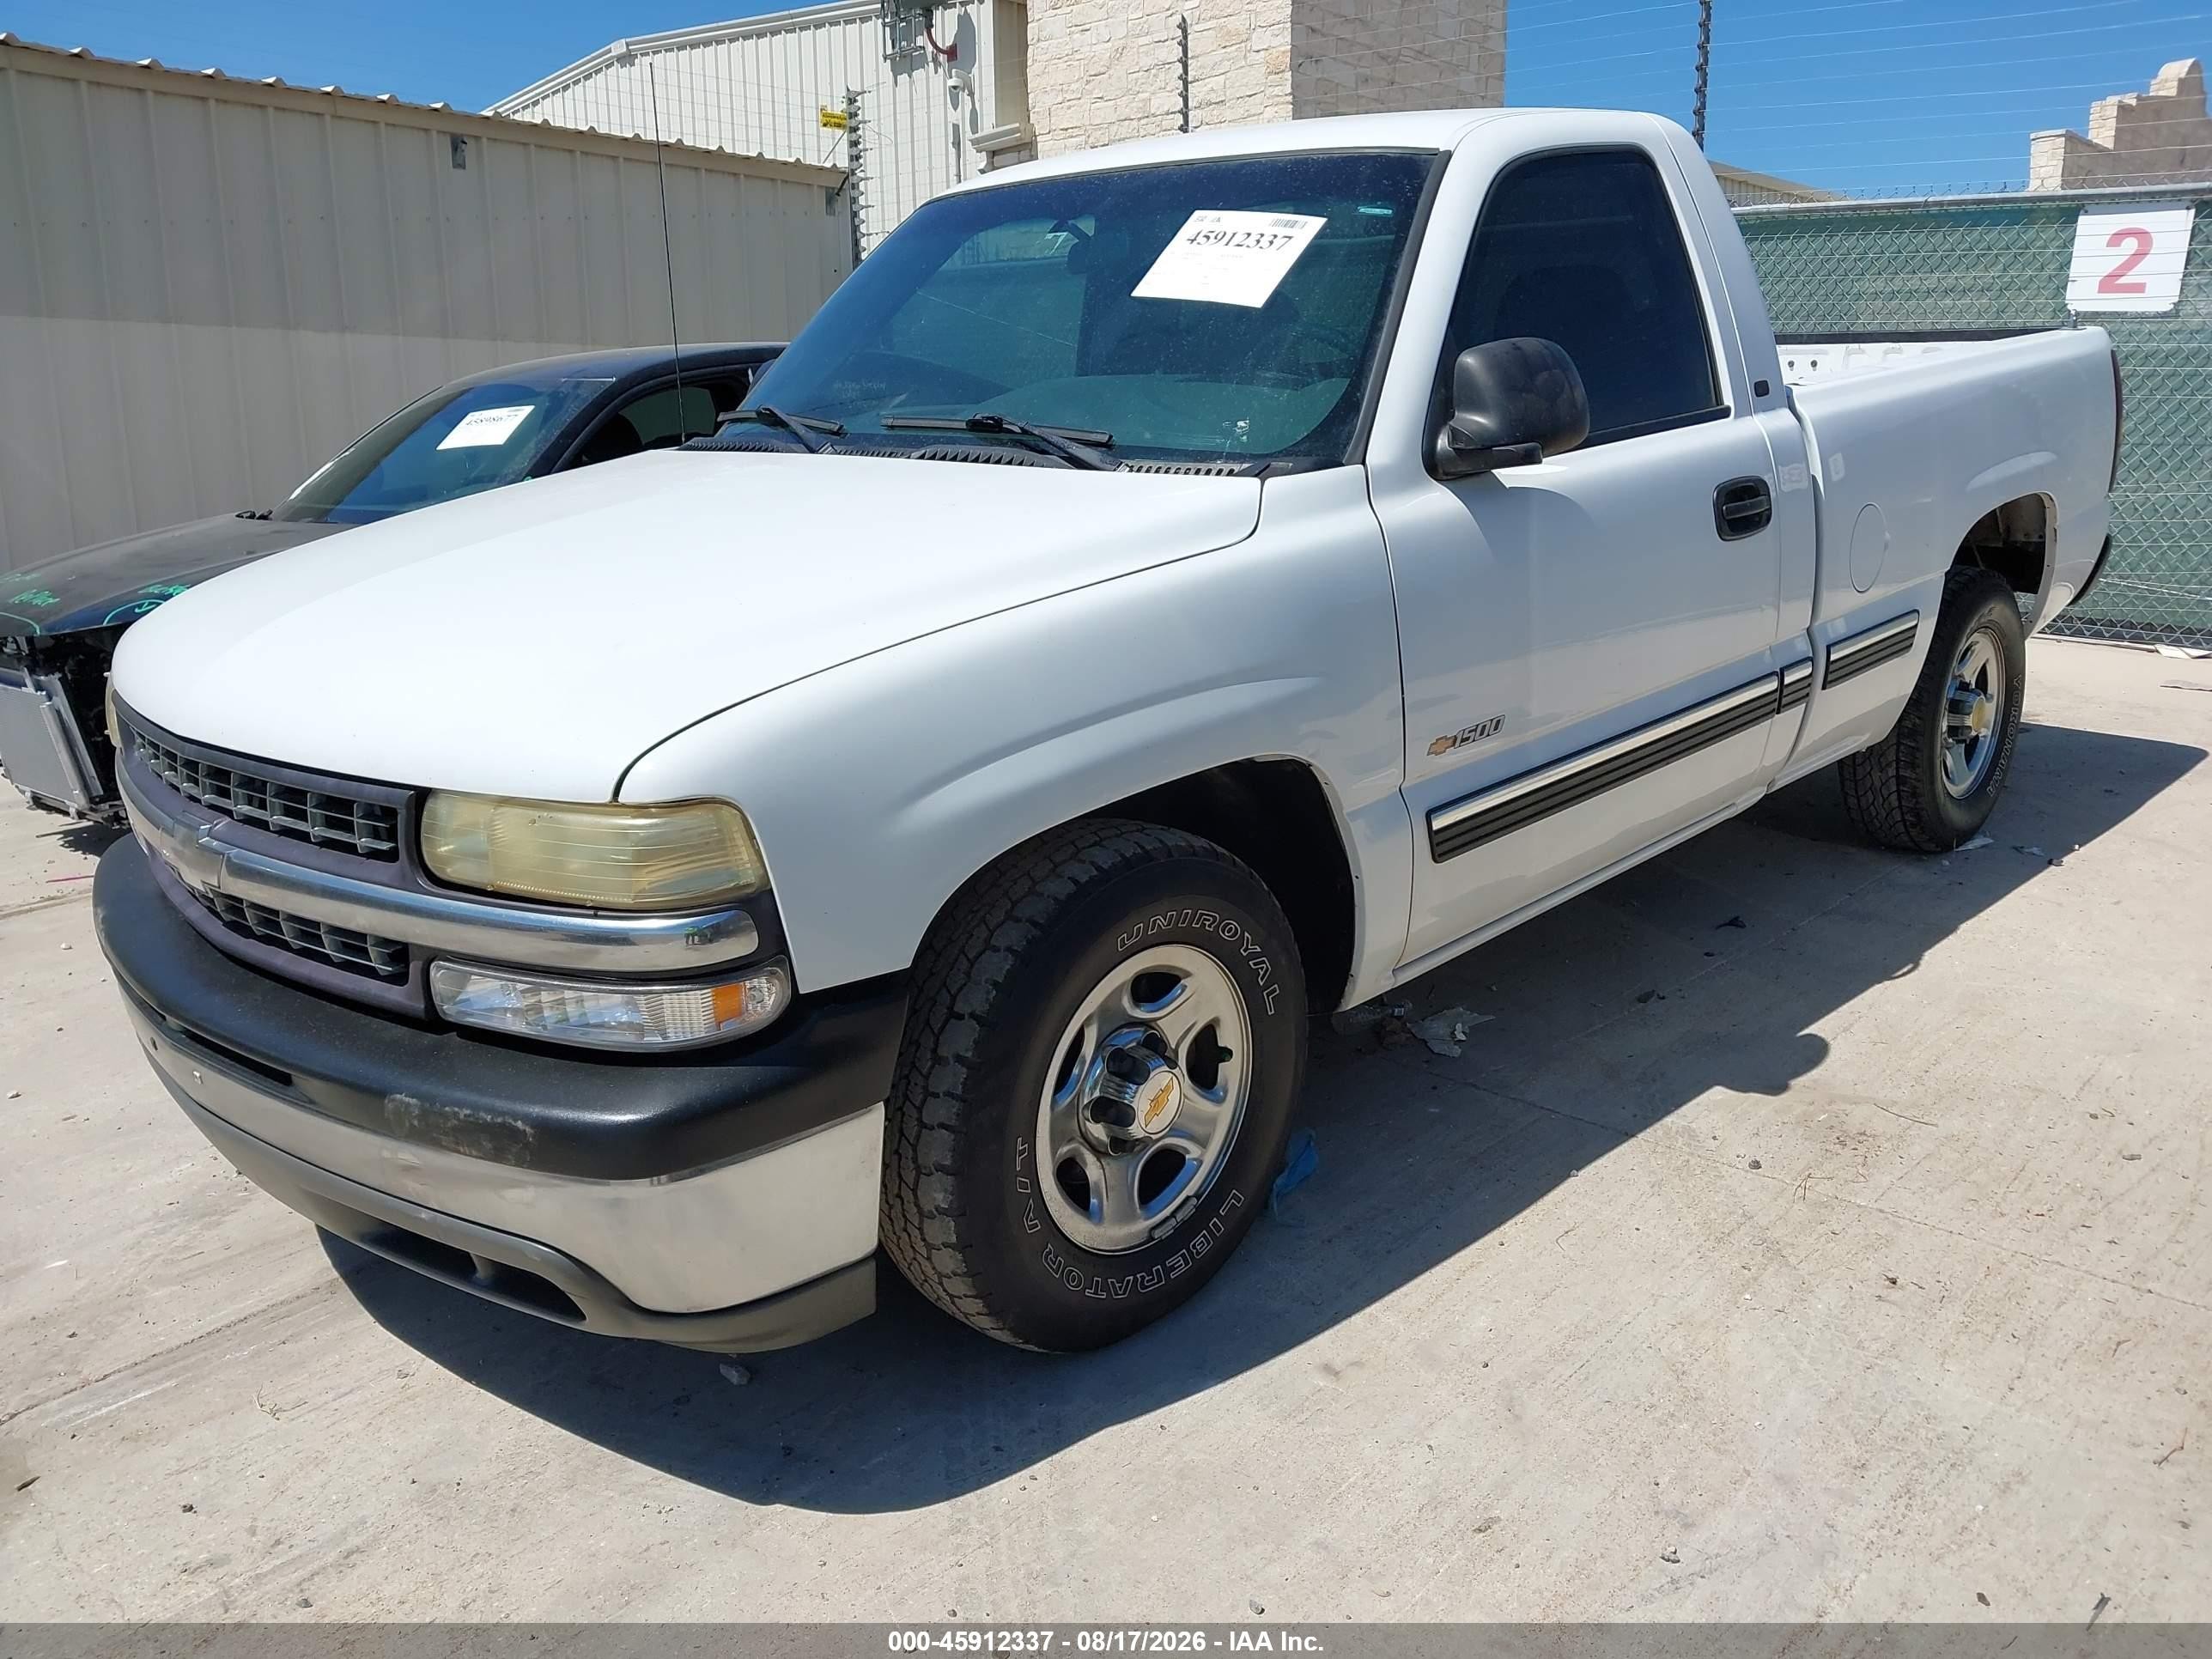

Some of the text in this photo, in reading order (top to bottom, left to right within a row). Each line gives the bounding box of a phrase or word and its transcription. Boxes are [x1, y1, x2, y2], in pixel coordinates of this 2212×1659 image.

[1187, 229, 1294, 251] 45912337
[2097, 227, 2154, 294] 2
[1453, 714, 1505, 749] 1500
[1117, 908, 1280, 1016] UNIROYAL
[1042, 1188, 1244, 1298] LIBERATOR
